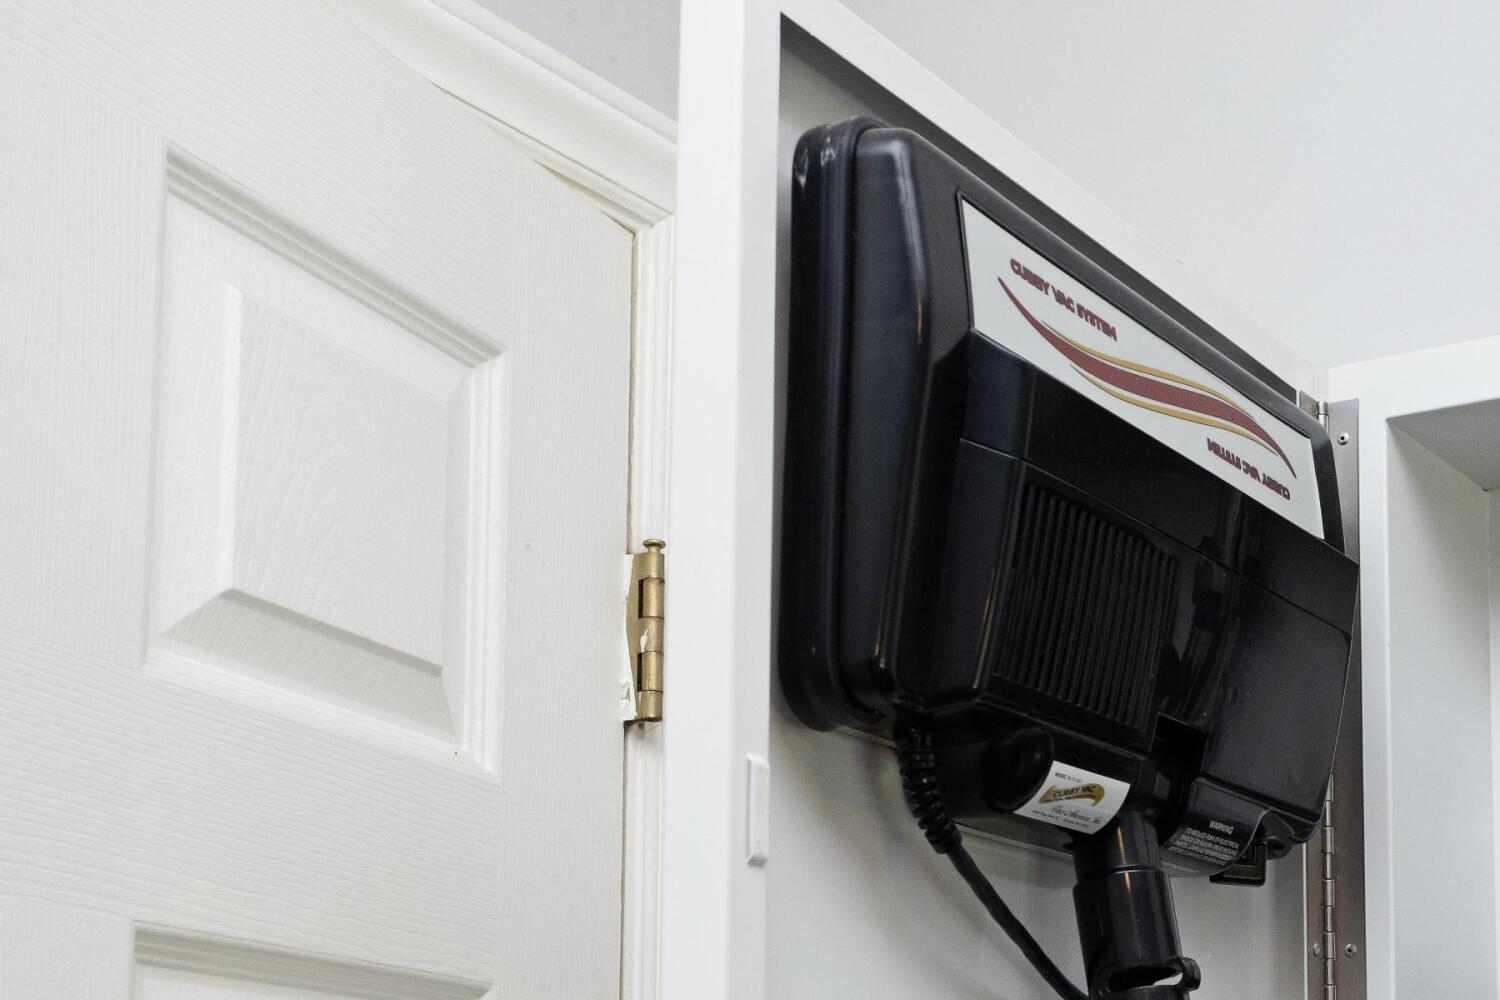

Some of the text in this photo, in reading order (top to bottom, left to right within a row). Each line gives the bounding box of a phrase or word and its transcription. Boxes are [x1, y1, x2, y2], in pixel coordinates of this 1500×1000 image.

[1010, 258, 1118, 341] CUBBY VAC SYSTEM
